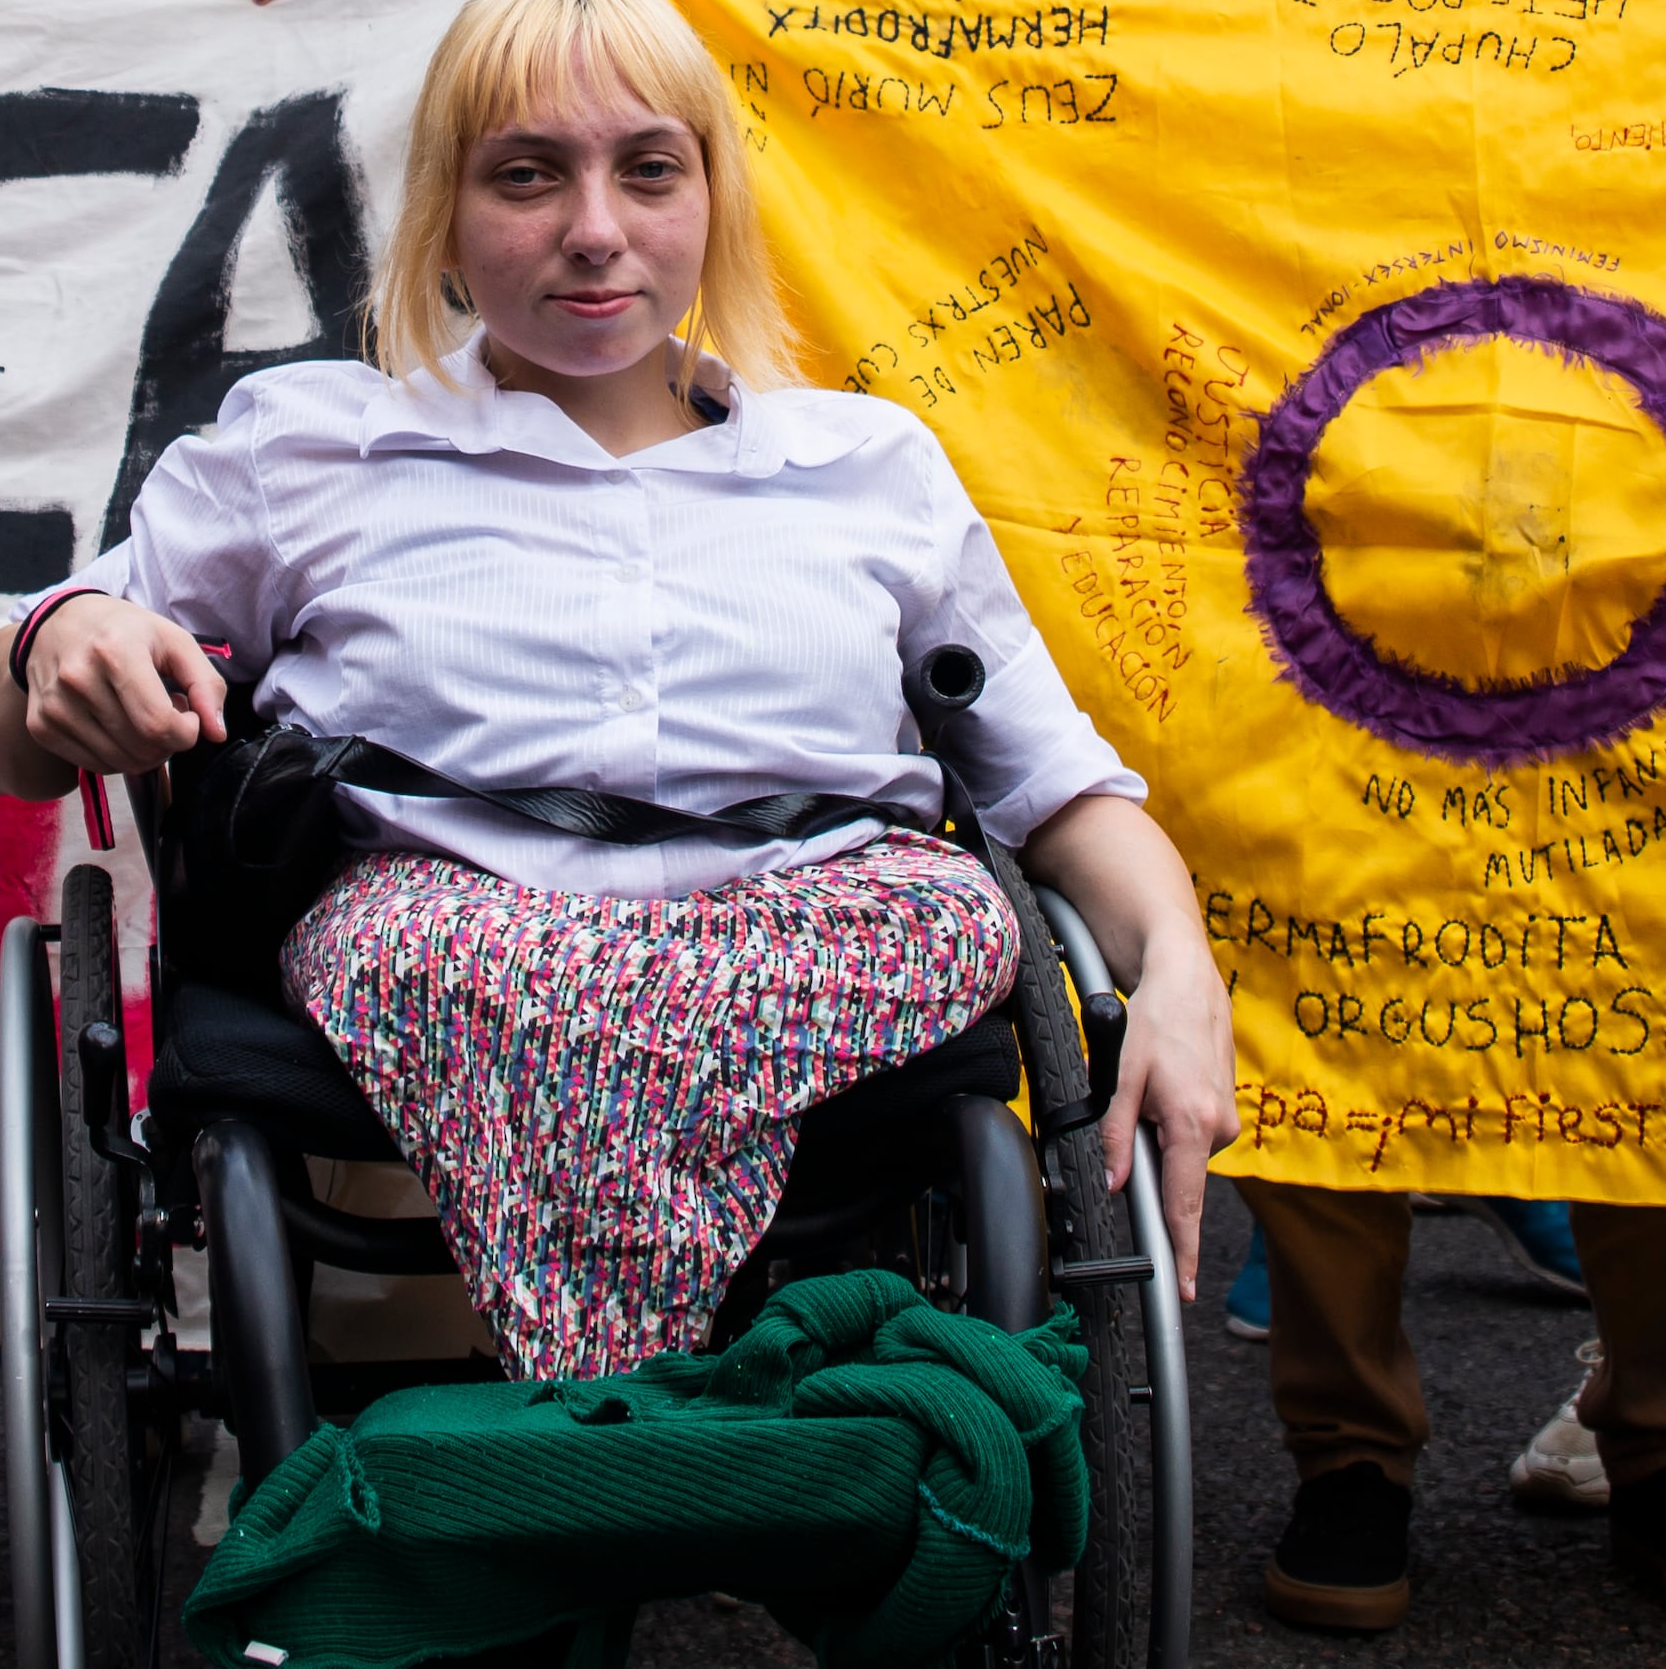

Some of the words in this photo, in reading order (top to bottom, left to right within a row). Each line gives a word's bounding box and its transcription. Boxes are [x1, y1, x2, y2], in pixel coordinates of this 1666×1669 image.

[981, 74, 1117, 129] ZEUS
[1494, 230, 1620, 271] FEMINISMO
[908, 226, 1048, 347] NUESTRXS
[973, 281, 1091, 373] PAREN
[841, 343, 898, 395] CUE
[910, 366, 956, 408] DE
[1363, 774, 1415, 819] NO
